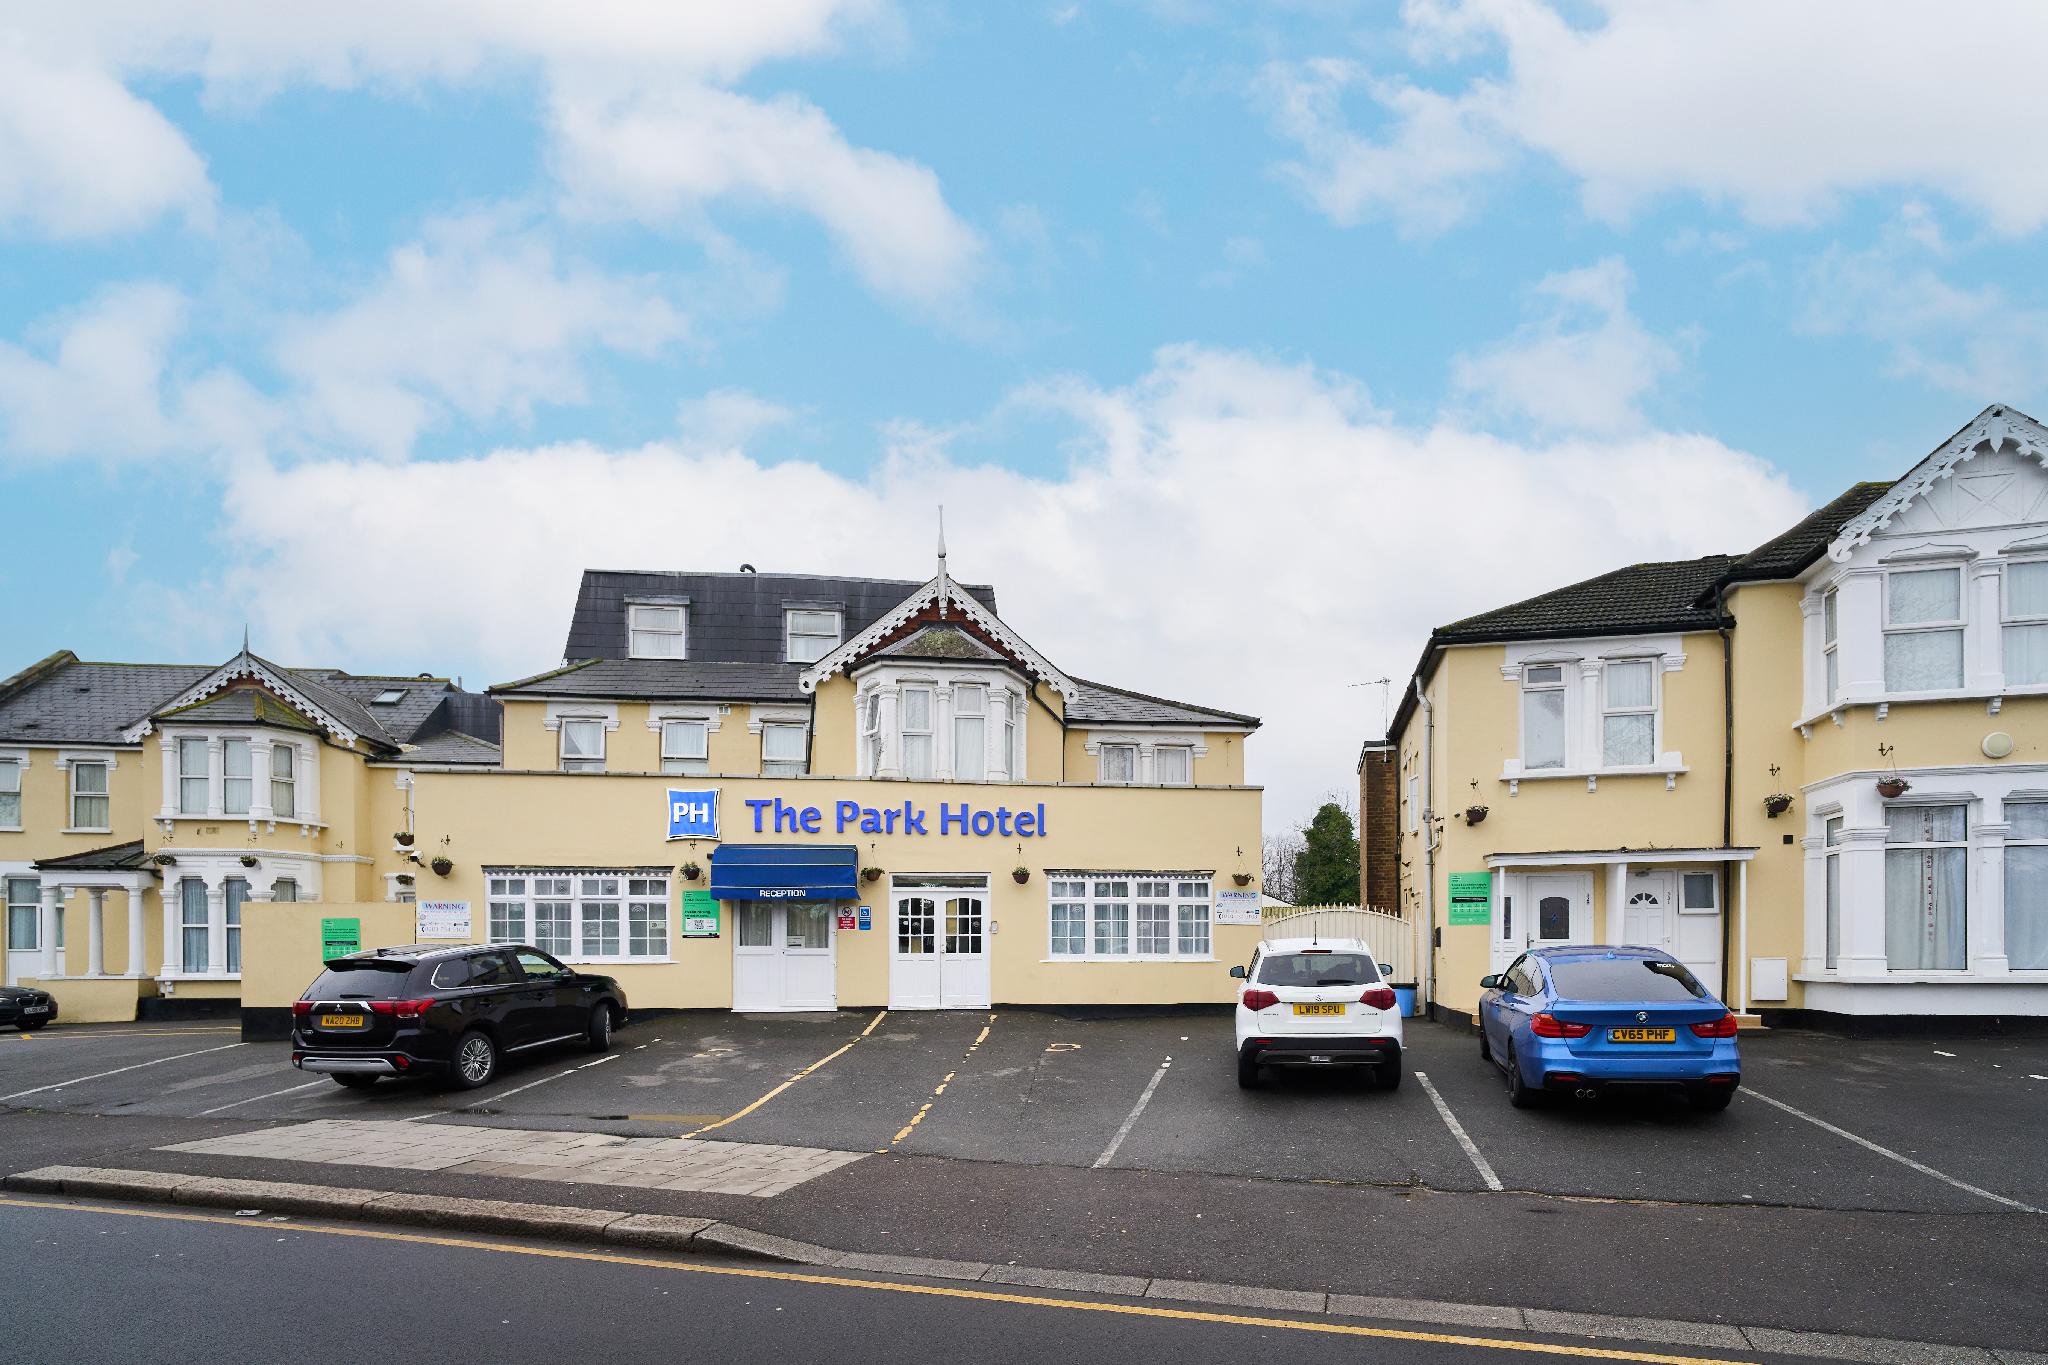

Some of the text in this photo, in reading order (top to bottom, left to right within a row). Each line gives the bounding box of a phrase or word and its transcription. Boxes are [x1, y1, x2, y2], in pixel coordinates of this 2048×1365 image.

[673, 802, 709, 823] PH
[745, 797, 1047, 838] The Park Hotel
[759, 889, 806, 897] RECEPTION
[1299, 1005, 1340, 1014] LW19 SPU
[1612, 1029, 1670, 1040] CV65 PHF
